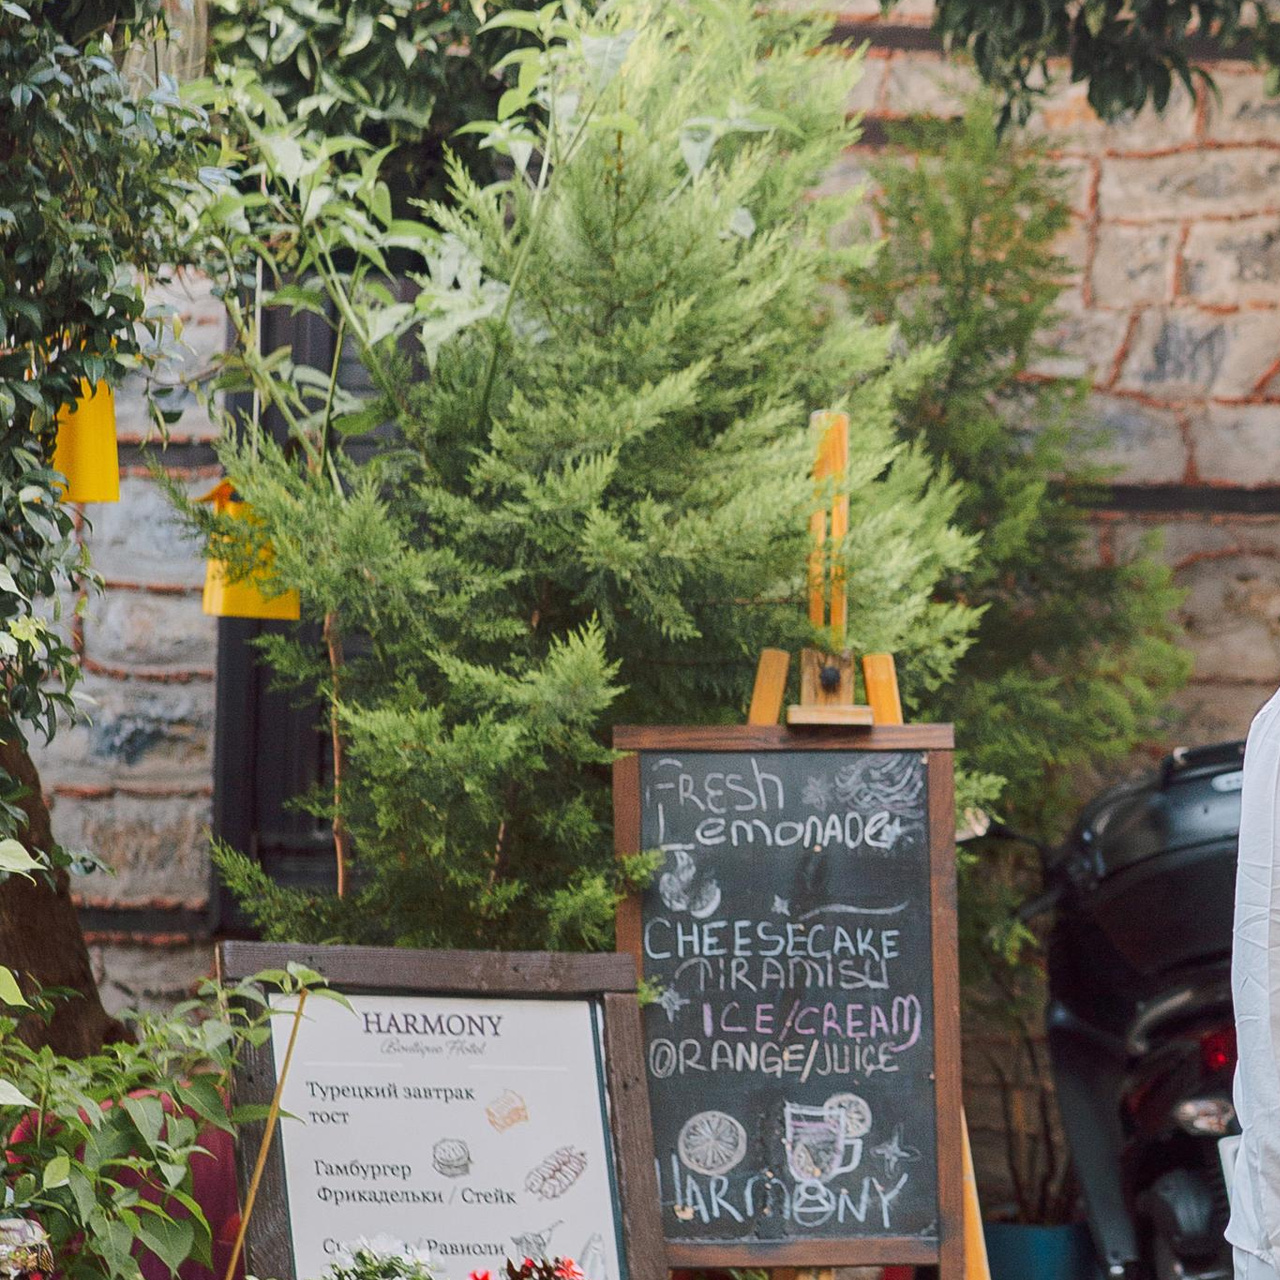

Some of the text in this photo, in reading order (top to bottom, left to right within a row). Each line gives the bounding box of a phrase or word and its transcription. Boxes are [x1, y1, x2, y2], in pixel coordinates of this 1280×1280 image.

[645, 916, 900, 961] CHEESECAKE
[362, 1011, 504, 1037] HARMONY
[306, 1081, 476, 1103] Турецкий завтрак
[309, 1111, 350, 1125] тост
[314, 1159, 412, 1180] Гамбургер
[317, 1186, 444, 1206] Фрикадельки
[461, 1187, 518, 1205] Стейк
[427, 1239, 505, 1257] Равиоли
